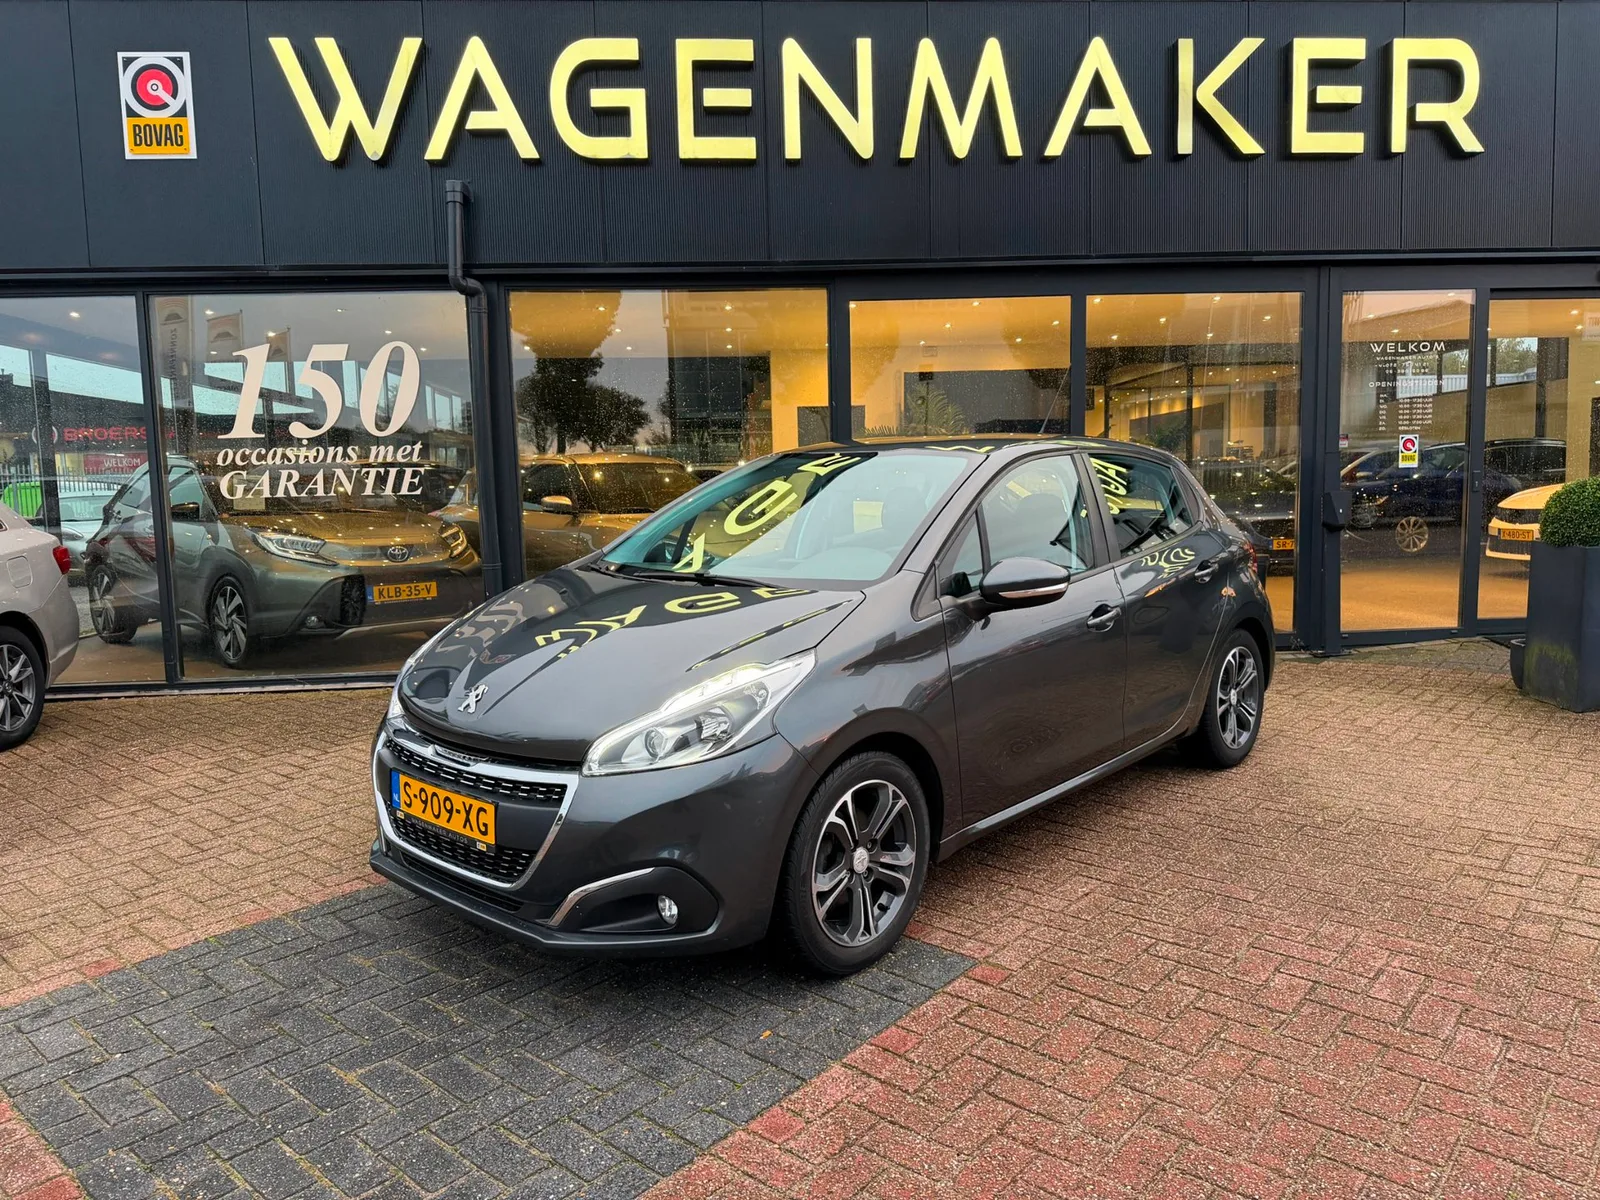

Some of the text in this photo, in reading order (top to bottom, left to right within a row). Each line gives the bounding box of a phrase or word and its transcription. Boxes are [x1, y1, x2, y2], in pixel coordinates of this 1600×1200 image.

[268, 36, 1484, 162] WAGENMAKER
[132, 123, 184, 148] BOVAG
[1370, 341, 1445, 353] WELKOM
[217, 340, 421, 439] 150
[103, 458, 141, 467] WELKOM
[217, 438, 423, 466] occasions met
[219, 467, 425, 500] GARANTIE
[378, 584, 432, 599] KLB-35-V
[403, 781, 489, 837] S-909-XG
